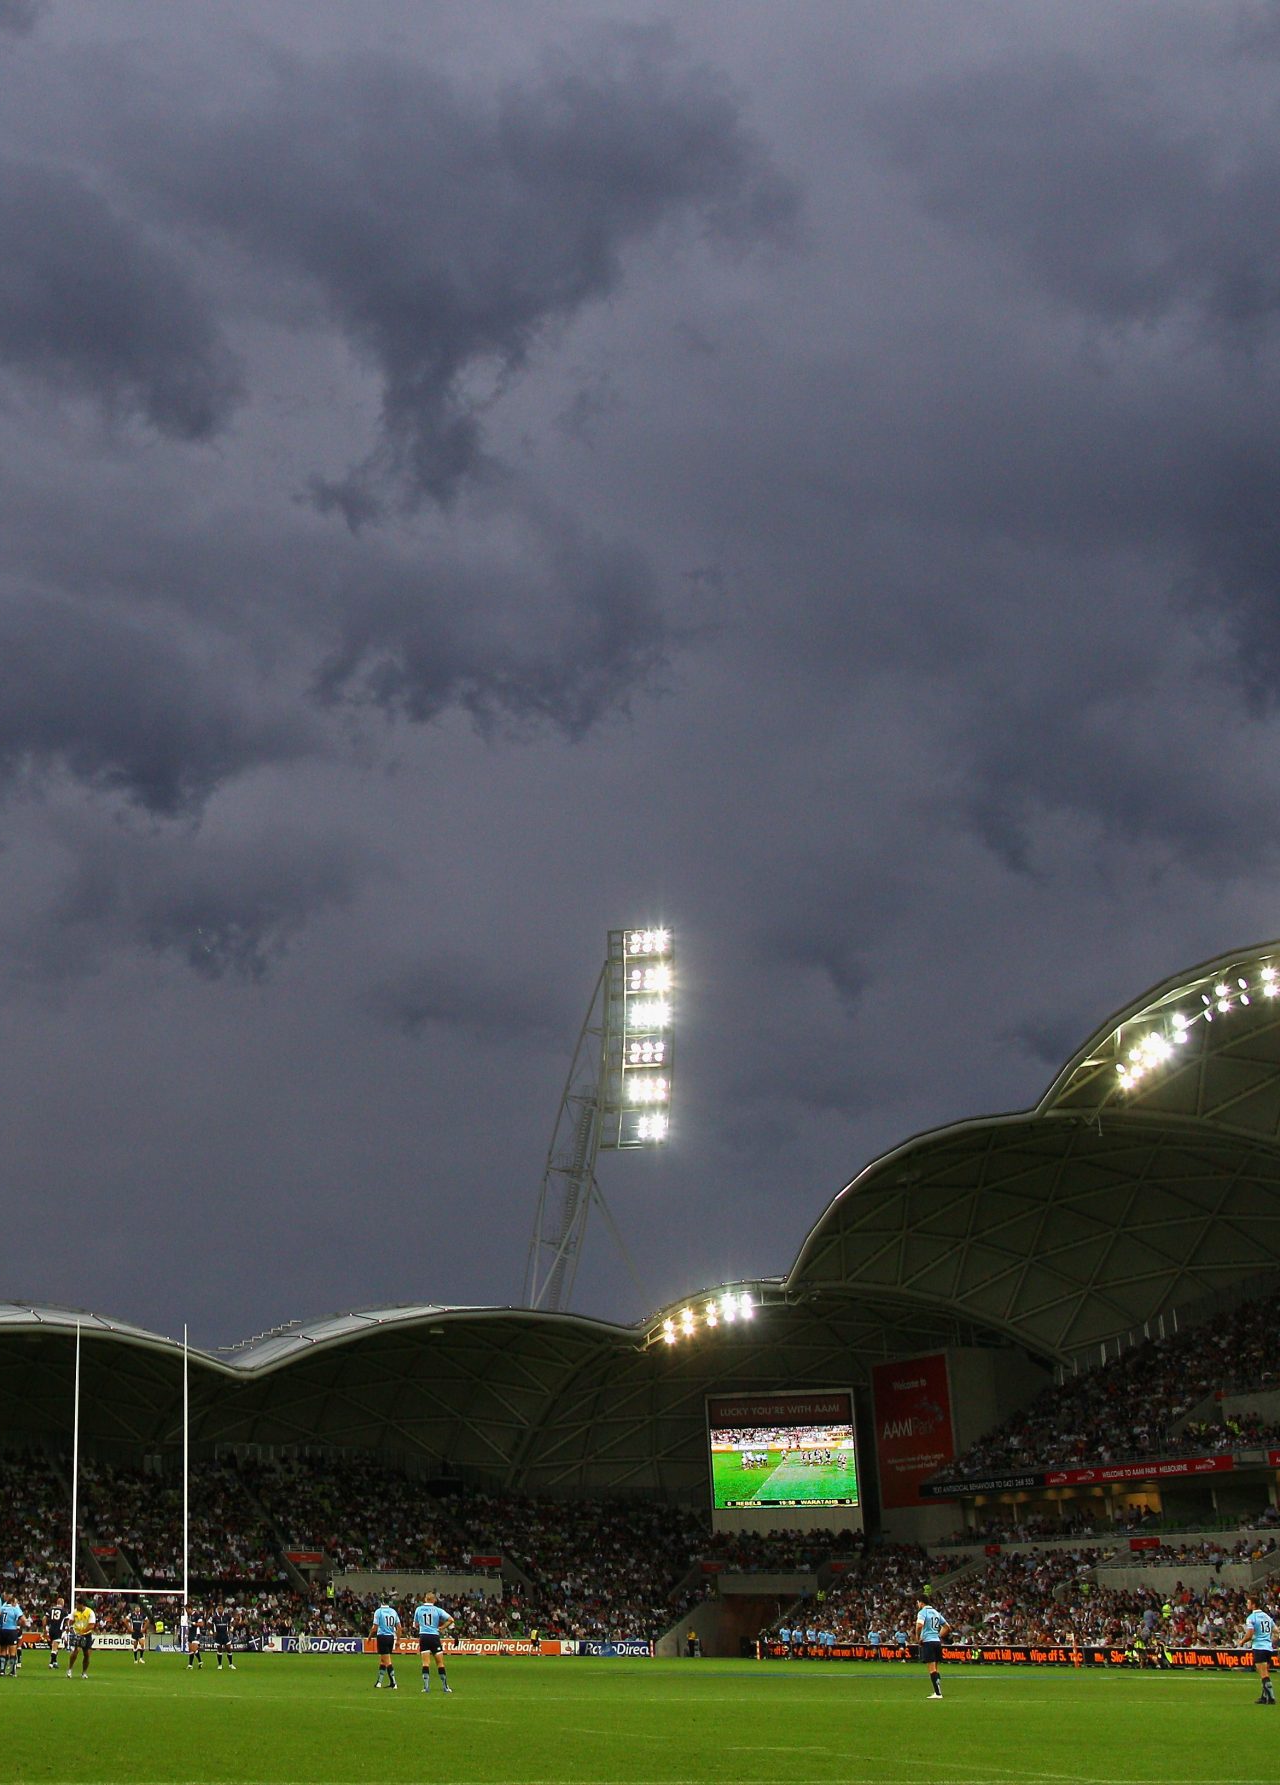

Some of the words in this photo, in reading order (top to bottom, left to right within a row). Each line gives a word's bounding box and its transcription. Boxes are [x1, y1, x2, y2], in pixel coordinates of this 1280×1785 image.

[720, 1408, 748, 1416] LUCKY
[787, 1405, 812, 1414] WITH
[814, 1404, 840, 1413] AAMI
[51, 1609, 61, 1620] 13
[422, 1613, 432, 1626] 11
[385, 1615, 395, 1627] 10
[930, 1617, 940, 1629] 12
[1260, 1620, 1271, 1633] 13
[483, 1640, 516, 1652] online
[880, 1648, 895, 1659] Wipe
[941, 1648, 966, 1661] Slowing
[983, 1649, 1001, 1660] won't
[1001, 1649, 1012, 1660] kill
[1029, 1650, 1047, 1663] Wipe
[1184, 1652, 1197, 1664] kill
[1197, 1654, 1214, 1666] you.
[1217, 1652, 1240, 1666] Wipe
[1240, 1653, 1254, 1666] off
